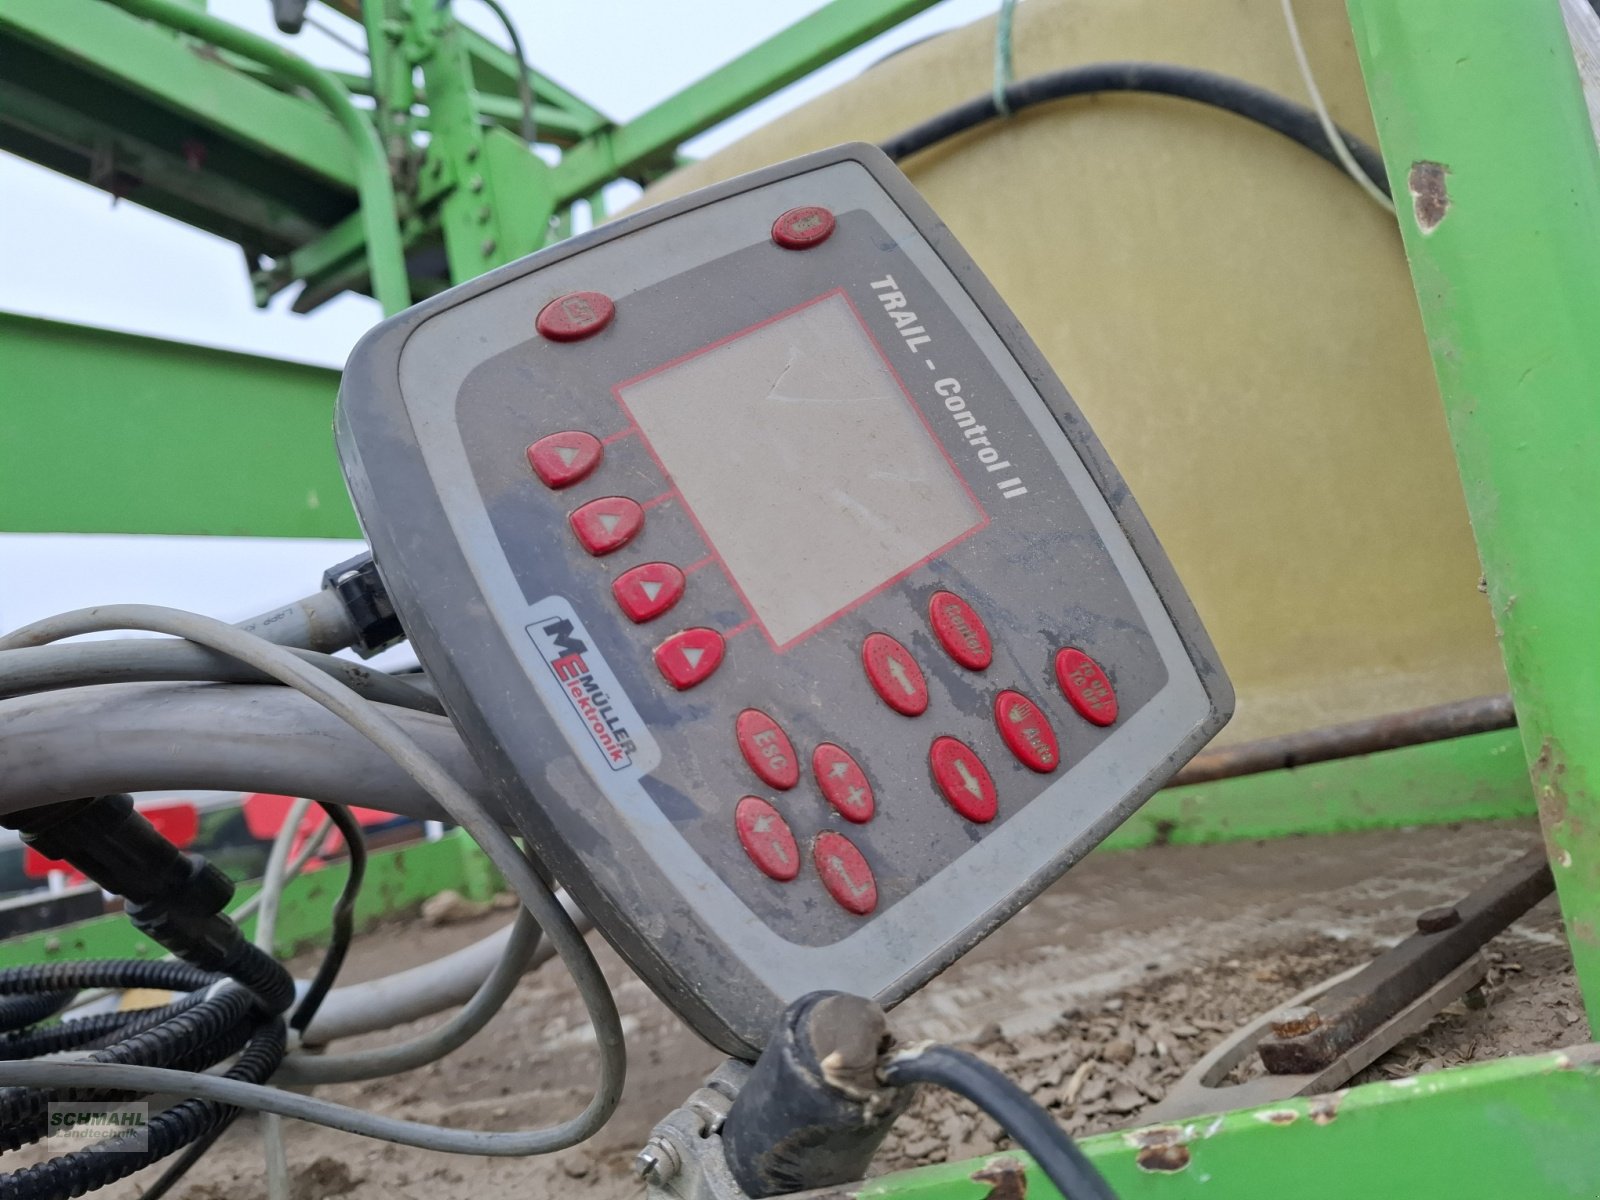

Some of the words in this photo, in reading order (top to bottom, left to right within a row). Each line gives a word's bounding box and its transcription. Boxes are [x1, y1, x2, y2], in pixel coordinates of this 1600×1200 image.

[870, 274, 931, 353] TRAIL
[934, 377, 1011, 473] Control
[996, 477, 1028, 499] II
[945, 604, 985, 655] Center
[579, 674, 637, 756] MÜLLER
[1022, 727, 1053, 764] Auto
